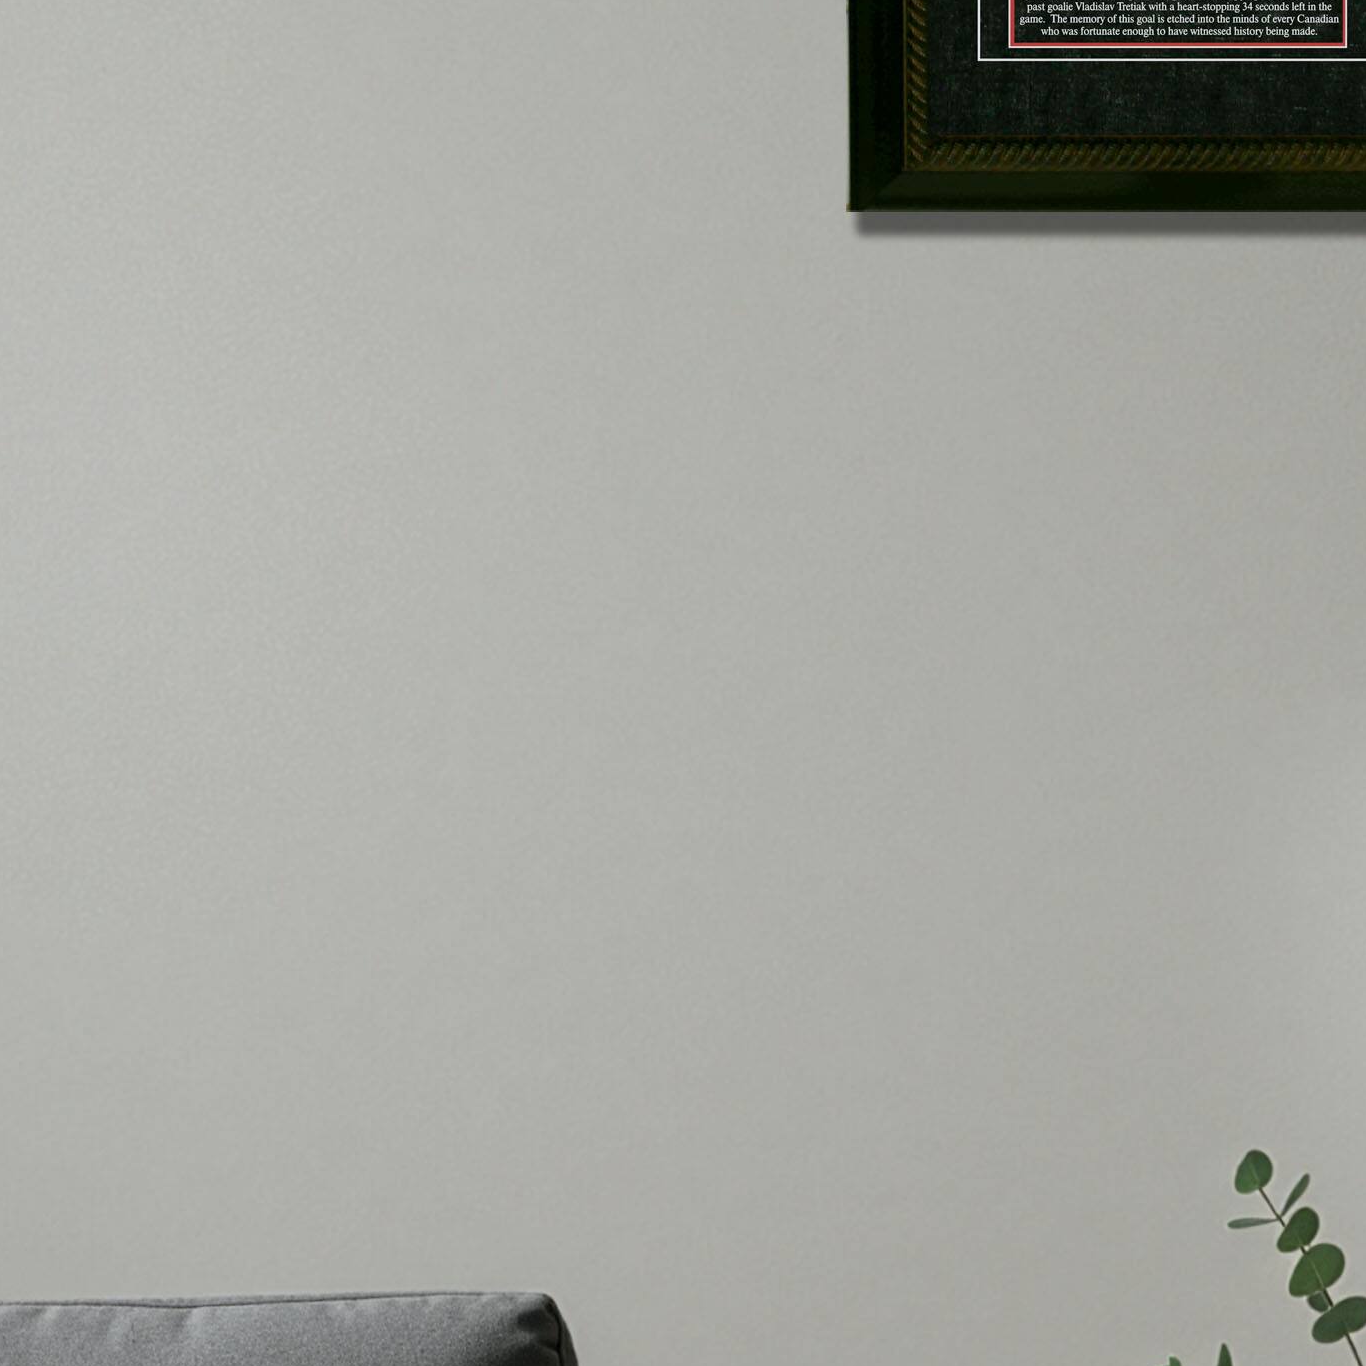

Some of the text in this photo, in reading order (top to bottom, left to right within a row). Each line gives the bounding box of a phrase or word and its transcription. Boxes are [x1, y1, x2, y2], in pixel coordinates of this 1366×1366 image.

[1041, 27, 1059, 35] who
[1081, 27, 1120, 35] fortunate
[1122, 27, 1155, 38] enough
[1168, 27, 1188, 35] have
[1190, 27, 1231, 35] witnessed
[1234, 27, 1264, 38] history
[1266, 27, 1289, 38] being
[1292, 27, 1317, 35] made.
